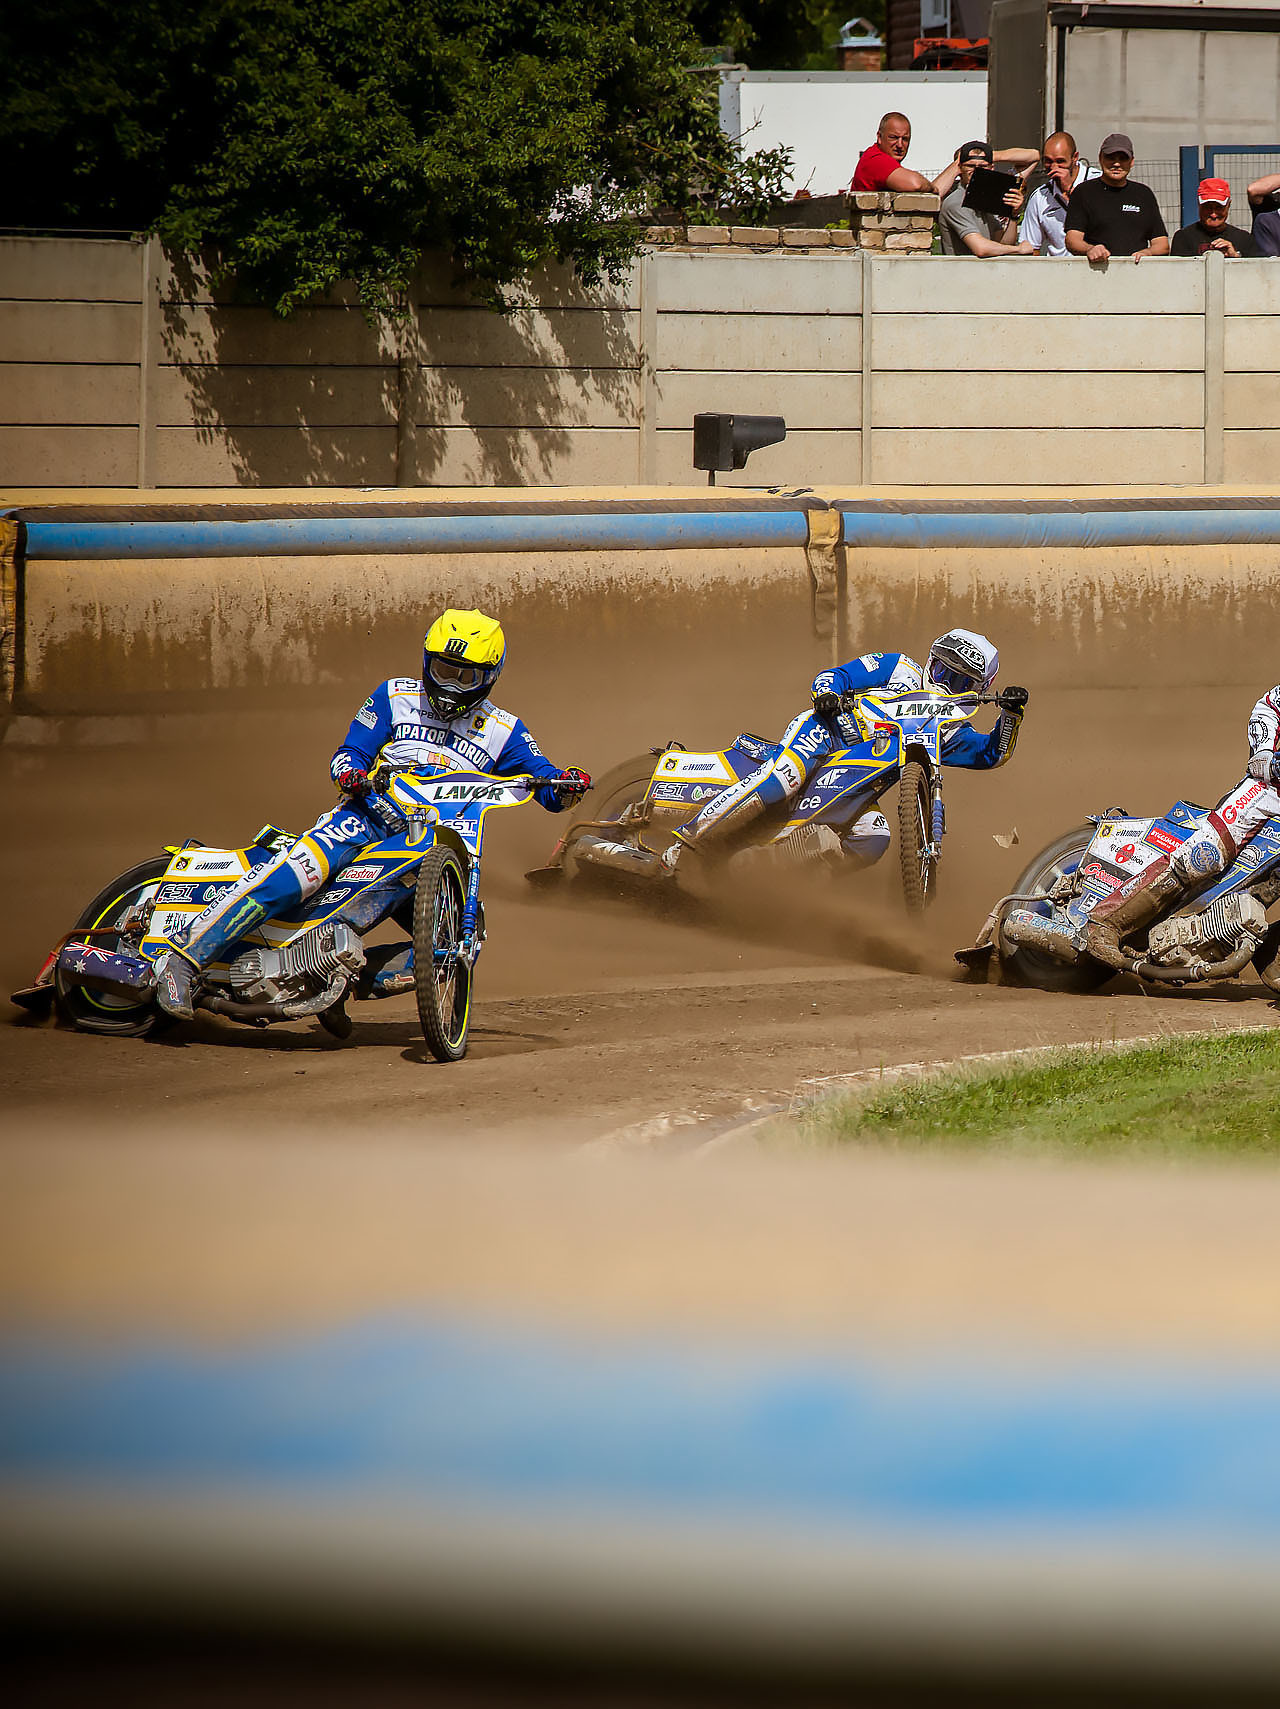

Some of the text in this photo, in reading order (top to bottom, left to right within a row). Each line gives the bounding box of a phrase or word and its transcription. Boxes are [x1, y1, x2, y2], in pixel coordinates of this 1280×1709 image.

[895, 703, 955, 717] LAVOR
[395, 724, 447, 744] APATOR
[433, 785, 505, 801] LAVOR
[655, 783, 688, 796] FST
[345, 869, 378, 879] Castrol
[160, 884, 200, 899] FST
